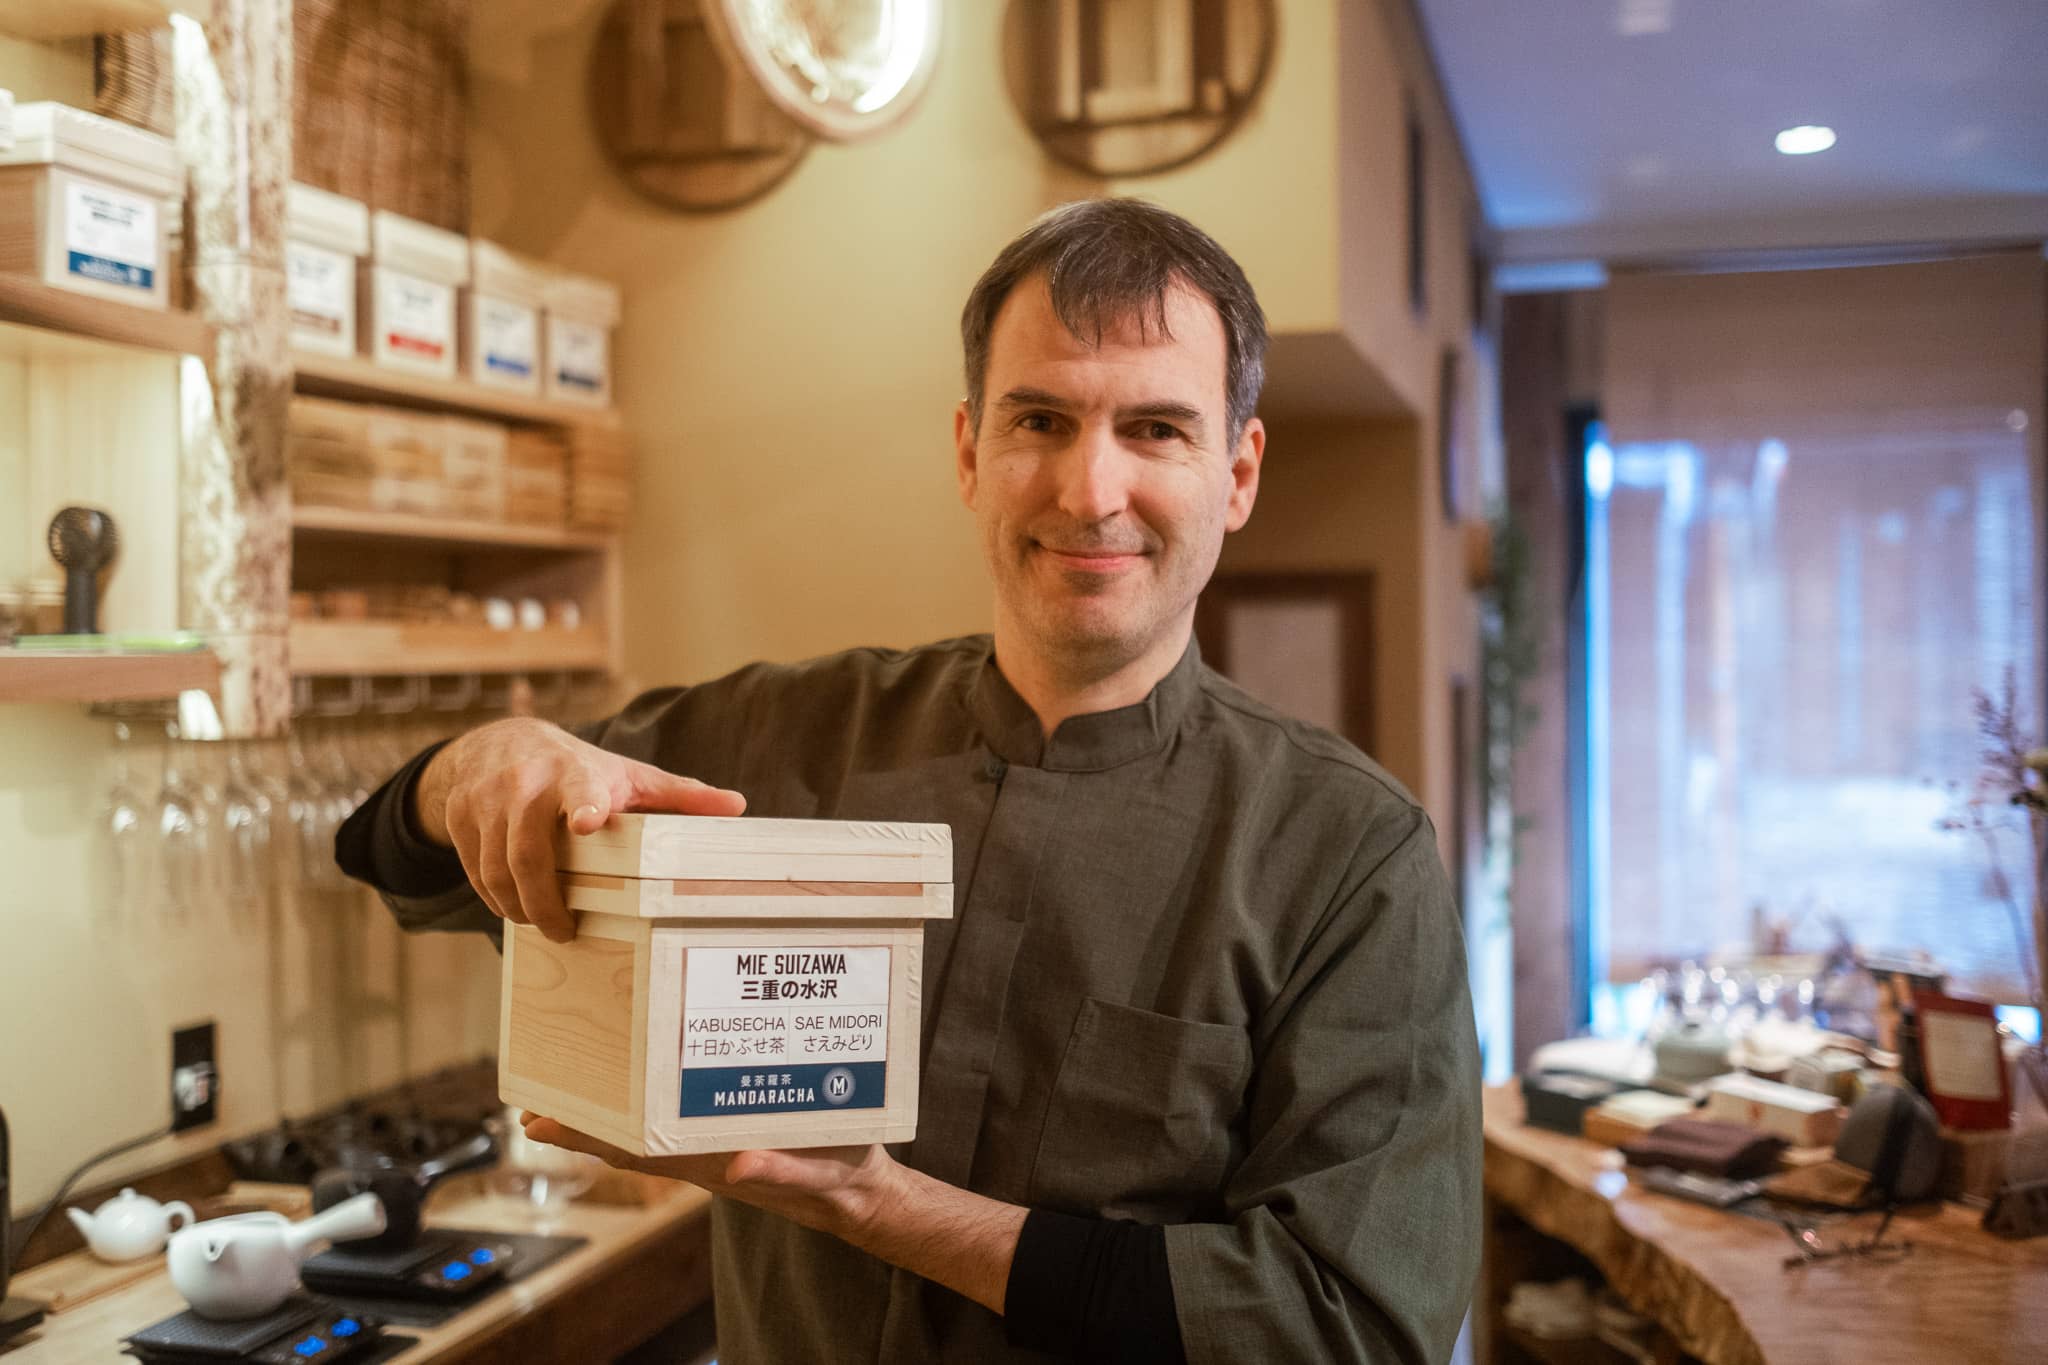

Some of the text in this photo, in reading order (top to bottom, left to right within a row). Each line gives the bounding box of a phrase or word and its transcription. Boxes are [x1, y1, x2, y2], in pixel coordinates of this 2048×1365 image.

[736, 953, 847, 975] MIE SUIZAWA
[740, 979, 838, 1001] 三重の水沢
[688, 1016, 785, 1033] KABUSECHA
[794, 1014, 882, 1031] SAE MIDORI
[687, 1037, 785, 1057] 十日かぶせ茶
[803, 1035, 873, 1054] さえみどり
[832, 1077, 846, 1095] M
[714, 1087, 816, 1107] MANDARACHA
